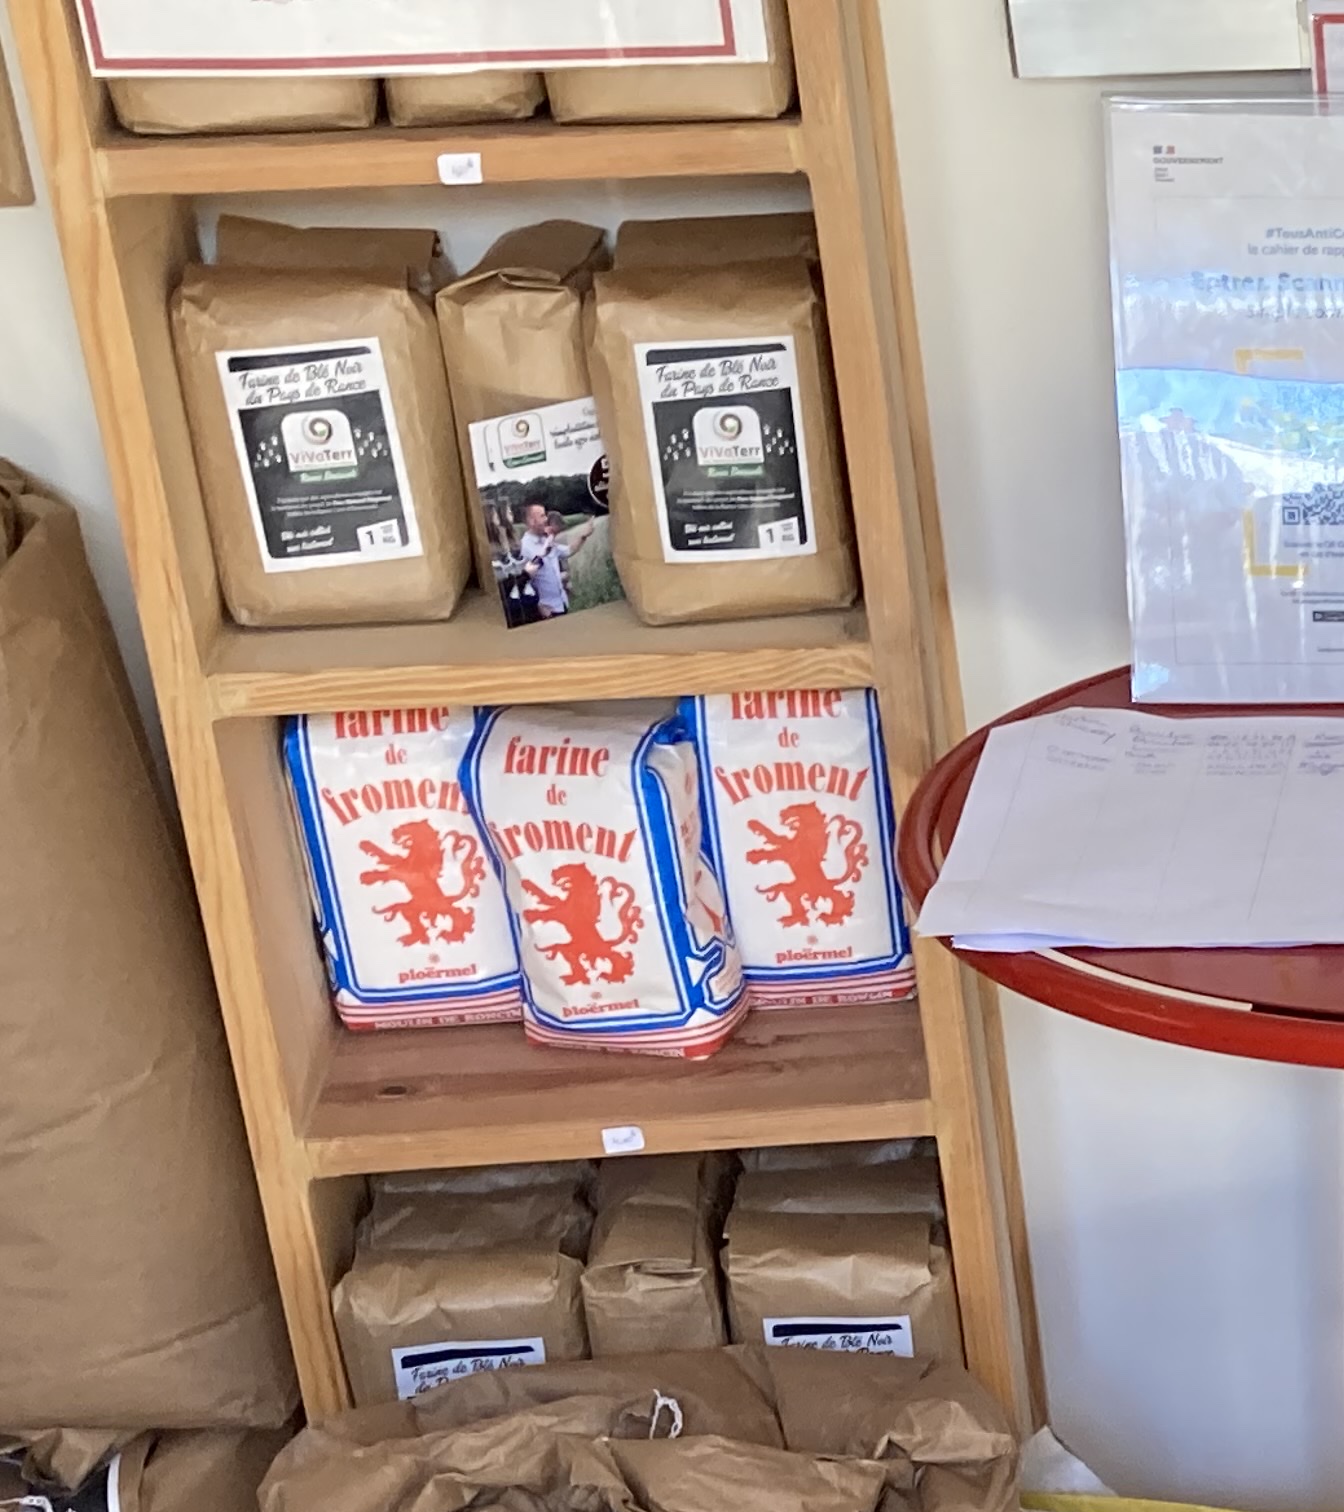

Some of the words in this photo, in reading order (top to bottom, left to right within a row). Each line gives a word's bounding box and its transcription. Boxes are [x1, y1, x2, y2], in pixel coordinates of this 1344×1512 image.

[1303, 243, 1319, 256] de
[284, 367, 301, 384] de
[700, 362, 716, 378] de
[365, 530, 375, 545] 1
[766, 528, 774, 543] 1
[730, 688, 843, 721] farine
[334, 706, 450, 740] farine
[778, 726, 800, 748] de
[385, 743, 408, 766] de
[503, 735, 610, 777] farine
[546, 783, 567, 806] de
[713, 760, 871, 806] froment
[320, 777, 471, 827] fromen
[488, 819, 638, 864] froment
